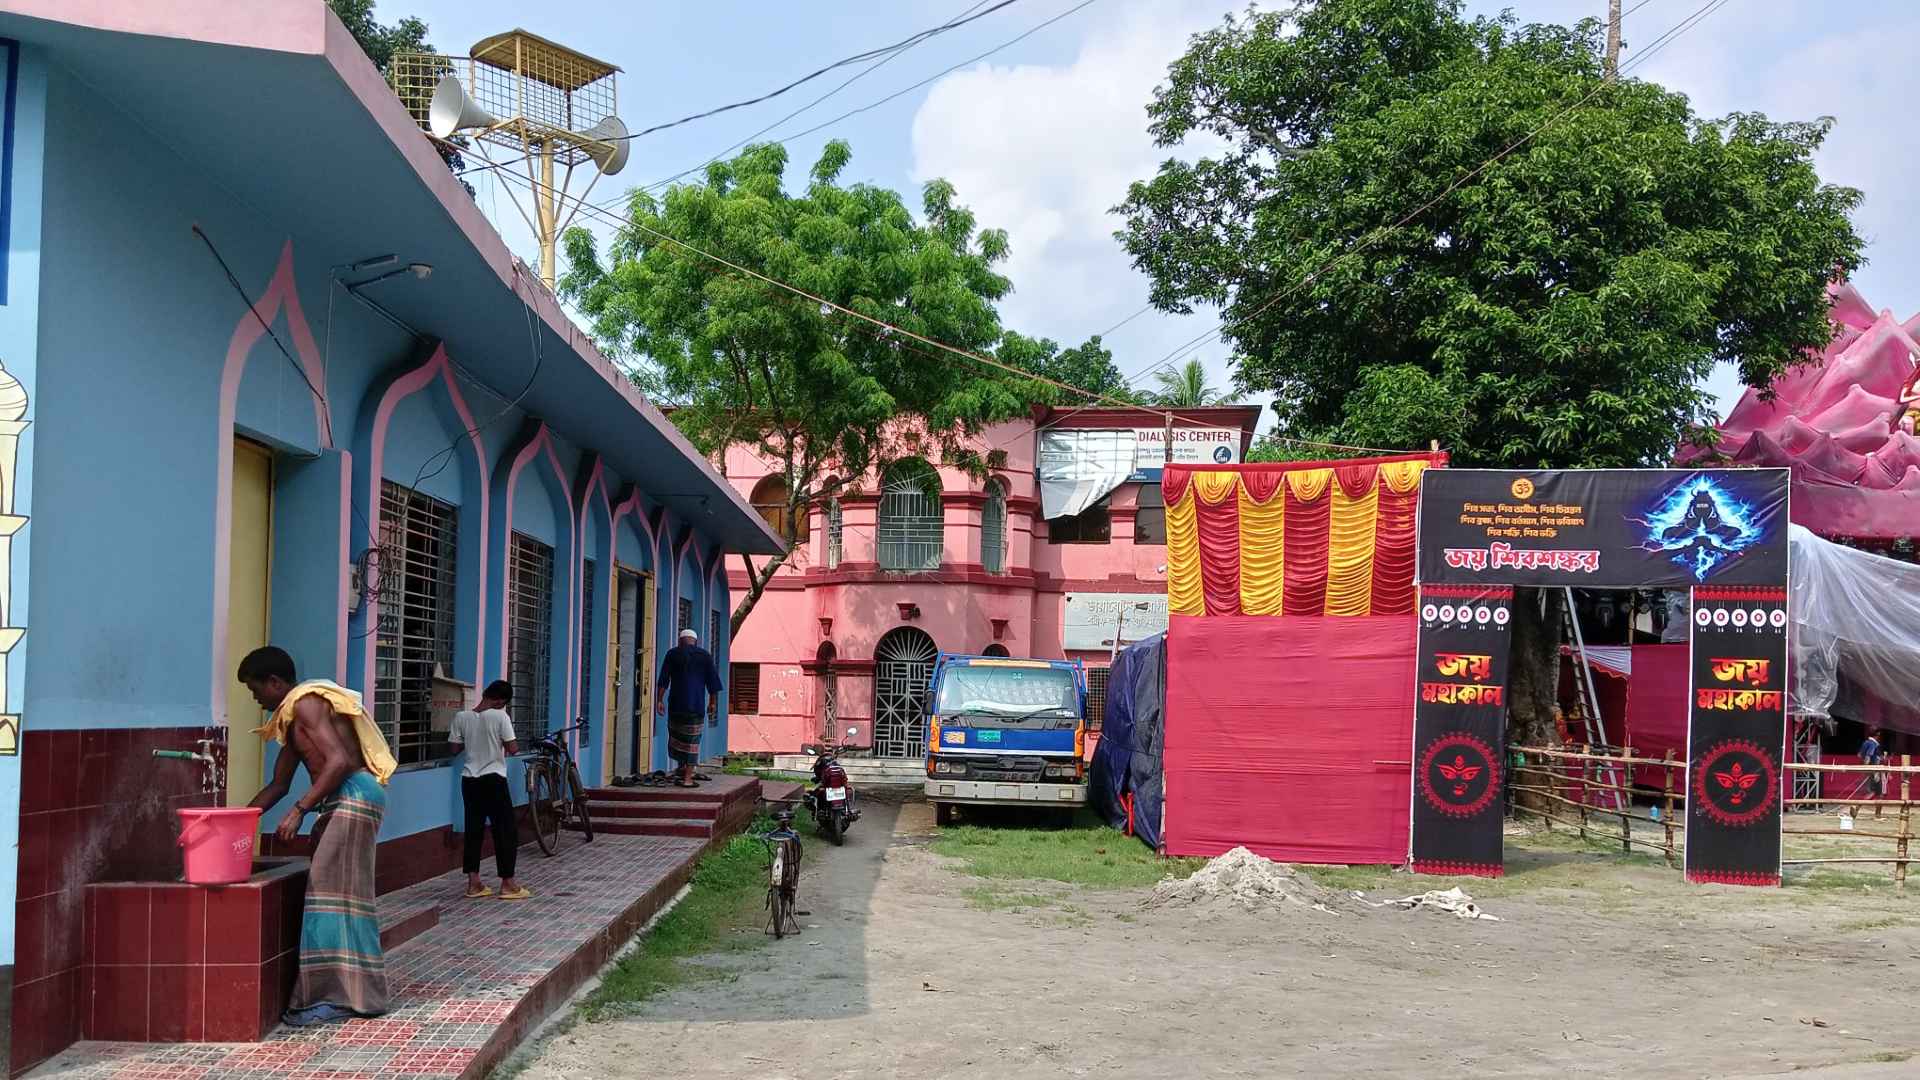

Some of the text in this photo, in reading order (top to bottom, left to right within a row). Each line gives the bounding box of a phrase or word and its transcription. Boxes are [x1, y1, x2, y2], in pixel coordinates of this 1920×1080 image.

[1189, 431, 1231, 442] CENTER
[1460, 514, 1475, 524] শিব
[1495, 515, 1510, 525] শিব
[1540, 516, 1555, 526] শিব
[1463, 503, 1479, 513] শিব
[1498, 503, 1513, 513] শিব
[1540, 504, 1555, 514] শিব
[1486, 527, 1501, 537] শিব
[1523, 527, 1538, 538] শিব
[1444, 541, 1600, 573] জয় শিবশঙ্কর
[1434, 653, 1492, 681] জয়
[1711, 658, 1770, 687] জয়
[1422, 682, 1503, 706] মহাকাল
[1697, 688, 1782, 712] মহাকাল
